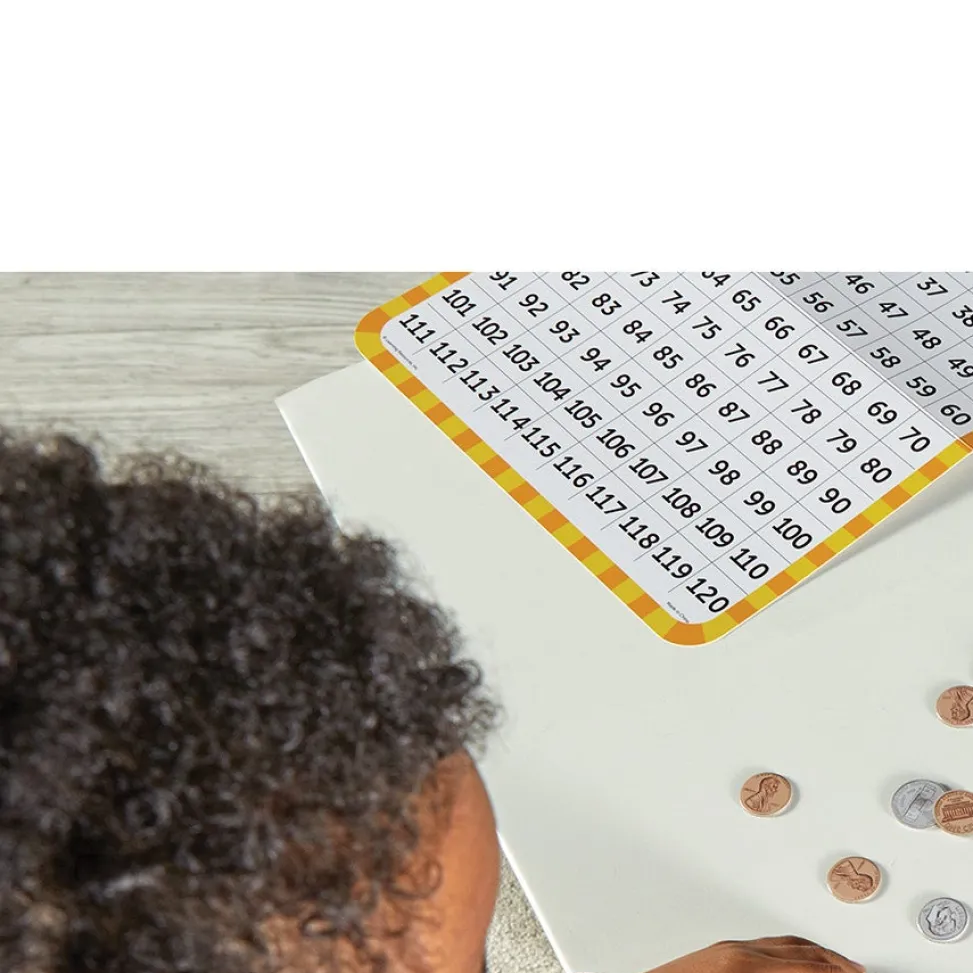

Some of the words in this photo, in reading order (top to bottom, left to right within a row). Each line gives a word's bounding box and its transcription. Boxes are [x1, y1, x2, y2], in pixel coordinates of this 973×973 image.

[732, 289, 762, 312] 65
[764, 316, 795, 340] 66
[798, 344, 829, 365] 67
[831, 371, 862, 396] 68
[867, 401, 898, 425] 69
[898, 426, 931, 453] 70
[802, 291, 835, 313] 56
[836, 319, 869, 337] 57
[869, 346, 901, 369] 58
[905, 376, 937, 397] 59
[940, 404, 972, 426] 60
[845, 275, 875, 295] 46
[878, 302, 909, 319] 47
[912, 329, 942, 350] 48
[916, 276, 949, 296] 37
[398, 314, 436, 344] 111
[429, 342, 469, 374] 112
[459, 370, 501, 401] 113
[490, 398, 532, 431] 114
[520, 427, 562, 458] 115
[553, 456, 595, 488] 116
[585, 486, 628, 514] 117
[618, 516, 660, 549] 118
[651, 546, 693, 579] 119
[685, 578, 730, 613] 120
[441, 289, 477, 318] 101
[471, 316, 509, 346] 102
[502, 344, 541, 372] 103
[533, 371, 572, 401] 104
[563, 399, 603, 429] 105
[595, 428, 636, 459] 106
[628, 458, 669, 485] 107
[661, 487, 702, 519] 108
[694, 517, 735, 548] 109
[729, 548, 770, 580] 110
[518, 293, 549, 318] 92
[549, 320, 581, 343] 93
[579, 347, 612, 372] 94
[610, 374, 642, 398] 95
[642, 402, 675, 427] 96
[675, 431, 709, 453] 97
[707, 460, 741, 486] 98
[743, 490, 776, 516] 99
[771, 518, 813, 550] 100
[591, 293, 622, 316] 83
[622, 319, 653, 344] 84
[652, 345, 684, 370] 85
[685, 373, 717, 398] 86
[718, 401, 751, 423] 87
[751, 429, 783, 455] 88
[786, 460, 818, 485] 89
[818, 487, 852, 514] 90
[661, 289, 692, 315] 74
[692, 315, 723, 340] 75
[724, 342, 756, 368] 76
[757, 370, 790, 393] 77
[790, 398, 822, 425] 78
[826, 428, 858, 454] 79
[860, 457, 893, 484] 80
